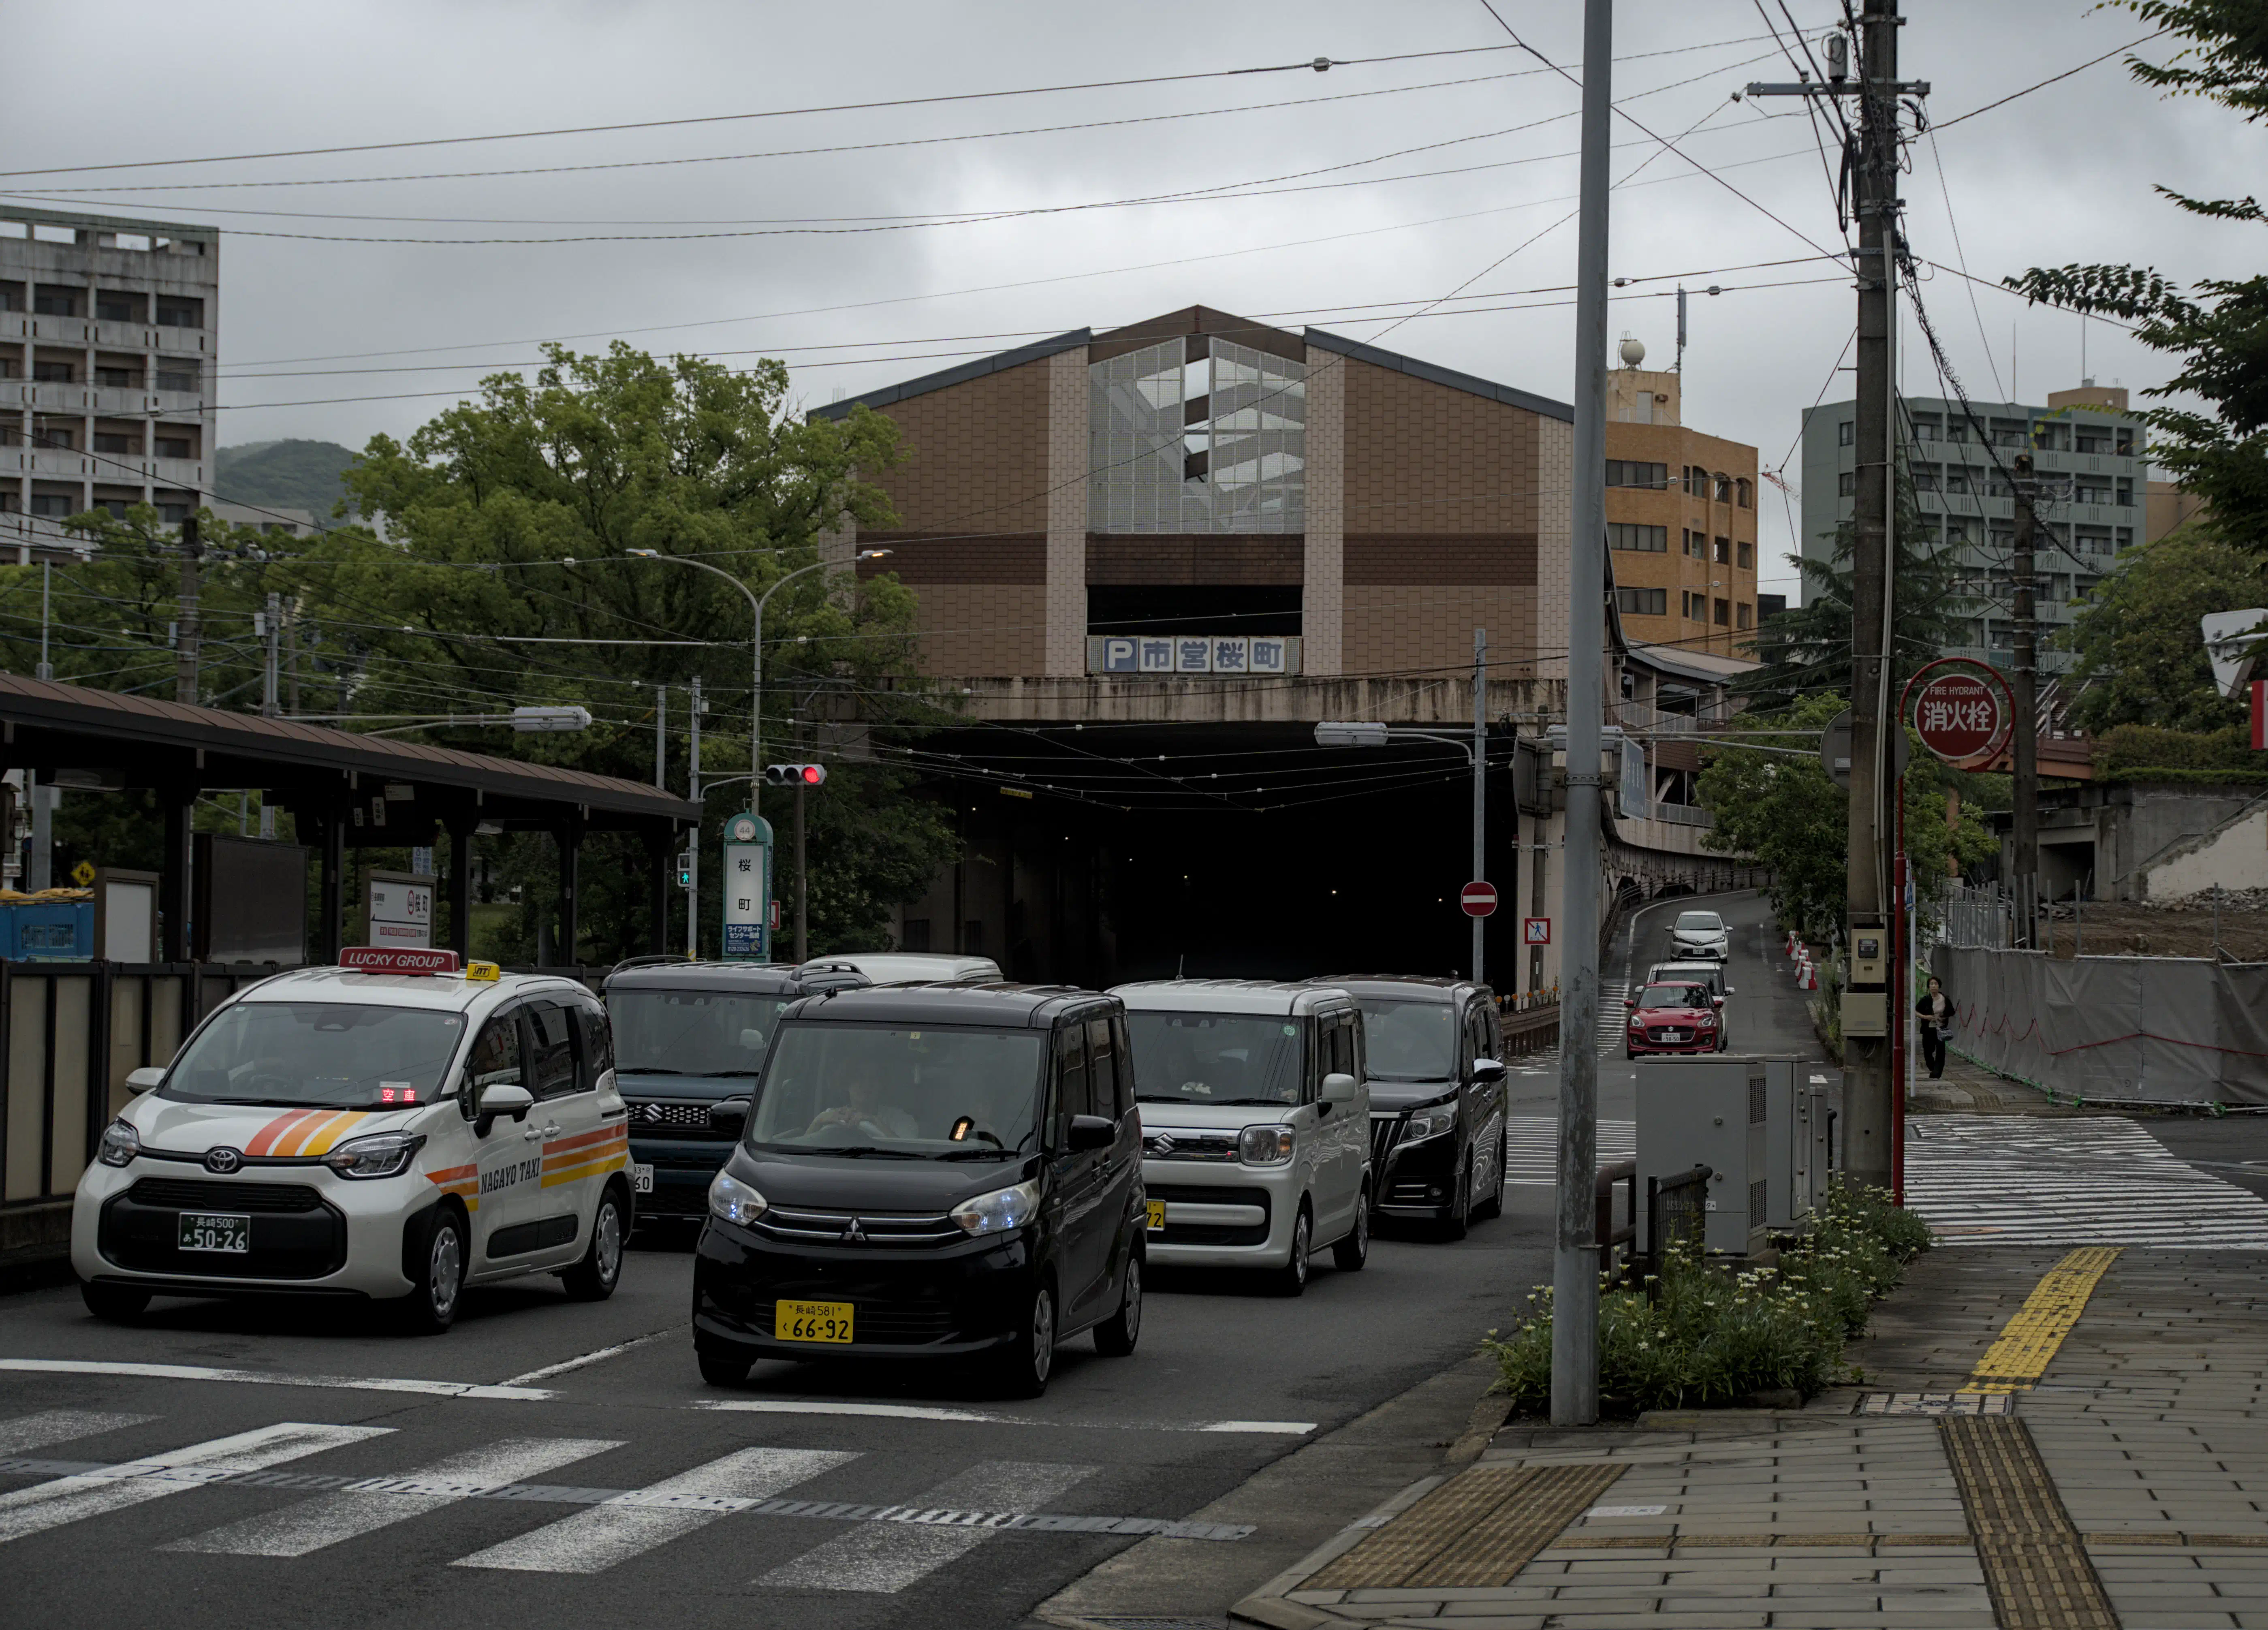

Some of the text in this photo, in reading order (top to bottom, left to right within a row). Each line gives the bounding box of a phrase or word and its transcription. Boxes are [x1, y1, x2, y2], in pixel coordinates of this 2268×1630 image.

[1108, 641, 1281, 669] P 市営桜町
[1930, 686, 1984, 695] FIRE HYDRANT
[1924, 700, 1992, 731] 消火栓
[739, 826, 750, 834] 44
[739, 859, 751, 911] 桜町
[348, 953, 445, 968] LUCKY GROUP
[481, 1157, 540, 1195] NAGAYO TAXI
[196, 1217, 235, 1228] 長崎500
[183, 1229, 246, 1250] あ 50-26
[795, 1305, 834, 1316] 長崎581
[783, 1318, 849, 1339] く 66-92
